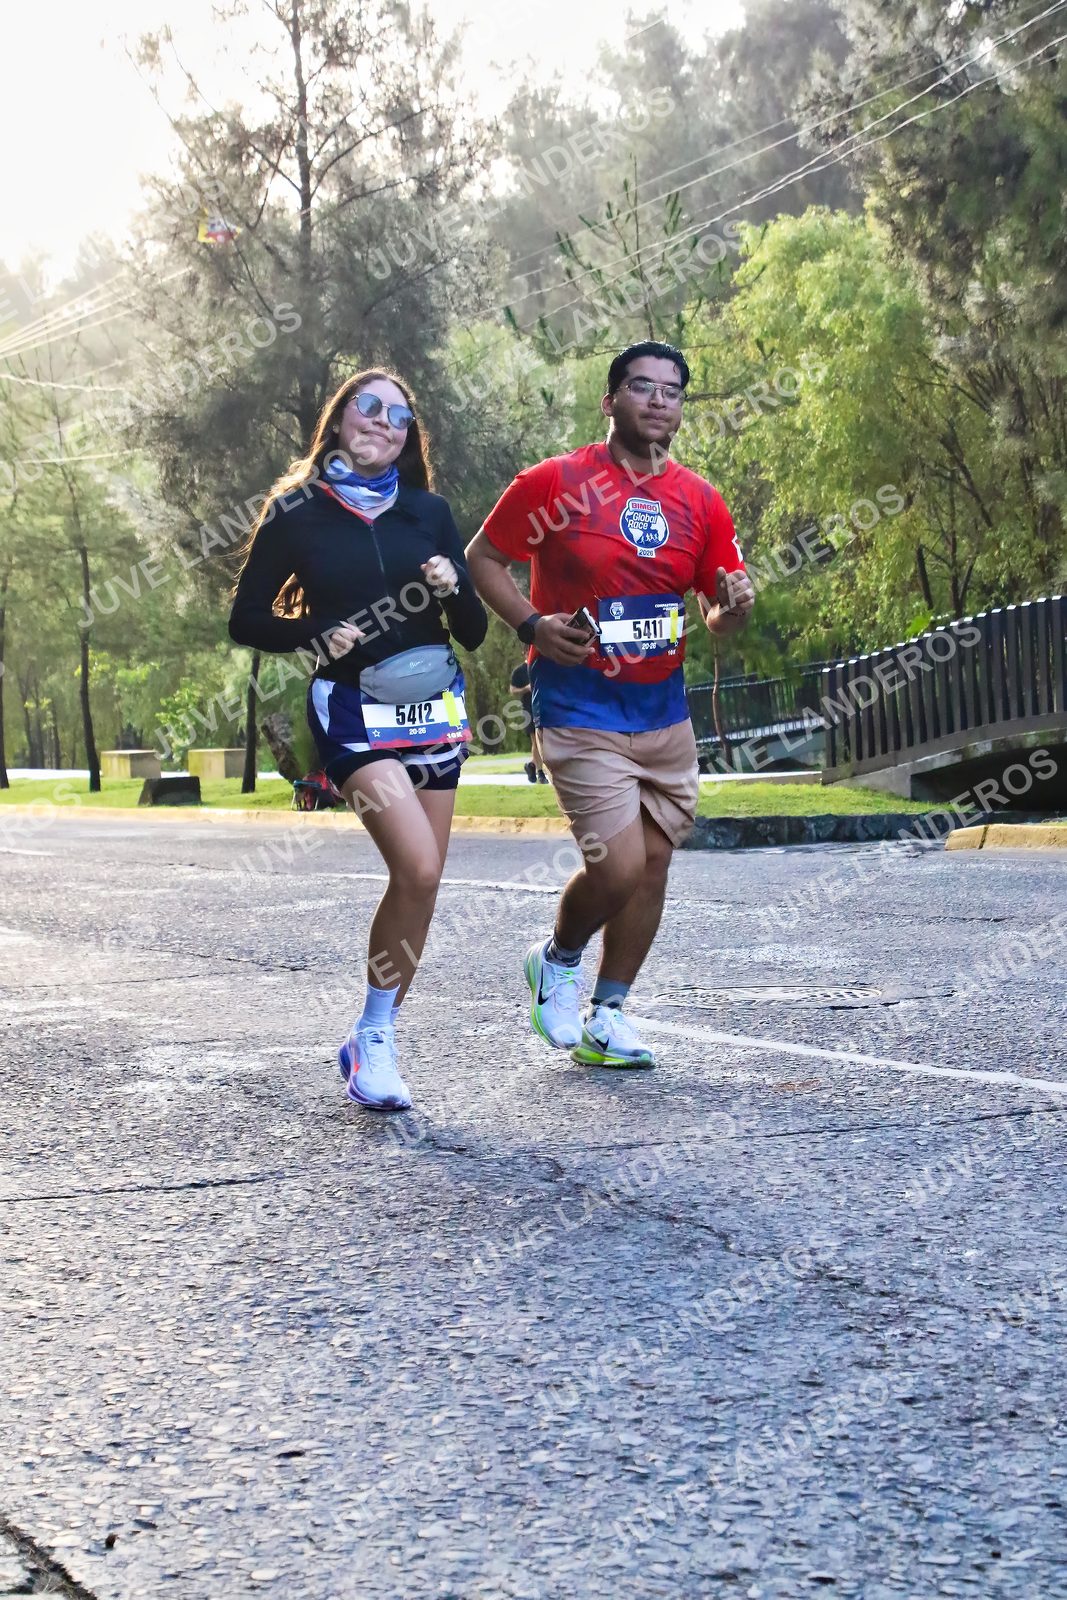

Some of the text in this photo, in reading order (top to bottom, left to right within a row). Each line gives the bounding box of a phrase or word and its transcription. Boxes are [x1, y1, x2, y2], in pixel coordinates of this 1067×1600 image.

[631, 503, 658, 512] BIMBO
[632, 512, 658, 525] Global
[627, 519, 649, 530] Race
[638, 549, 654, 557] 2026
[633, 620, 663, 639] 5411
[641, 642, 657, 650] 20-26
[396, 703, 435, 725] 5412
[408, 727, 427, 736] 20-26
